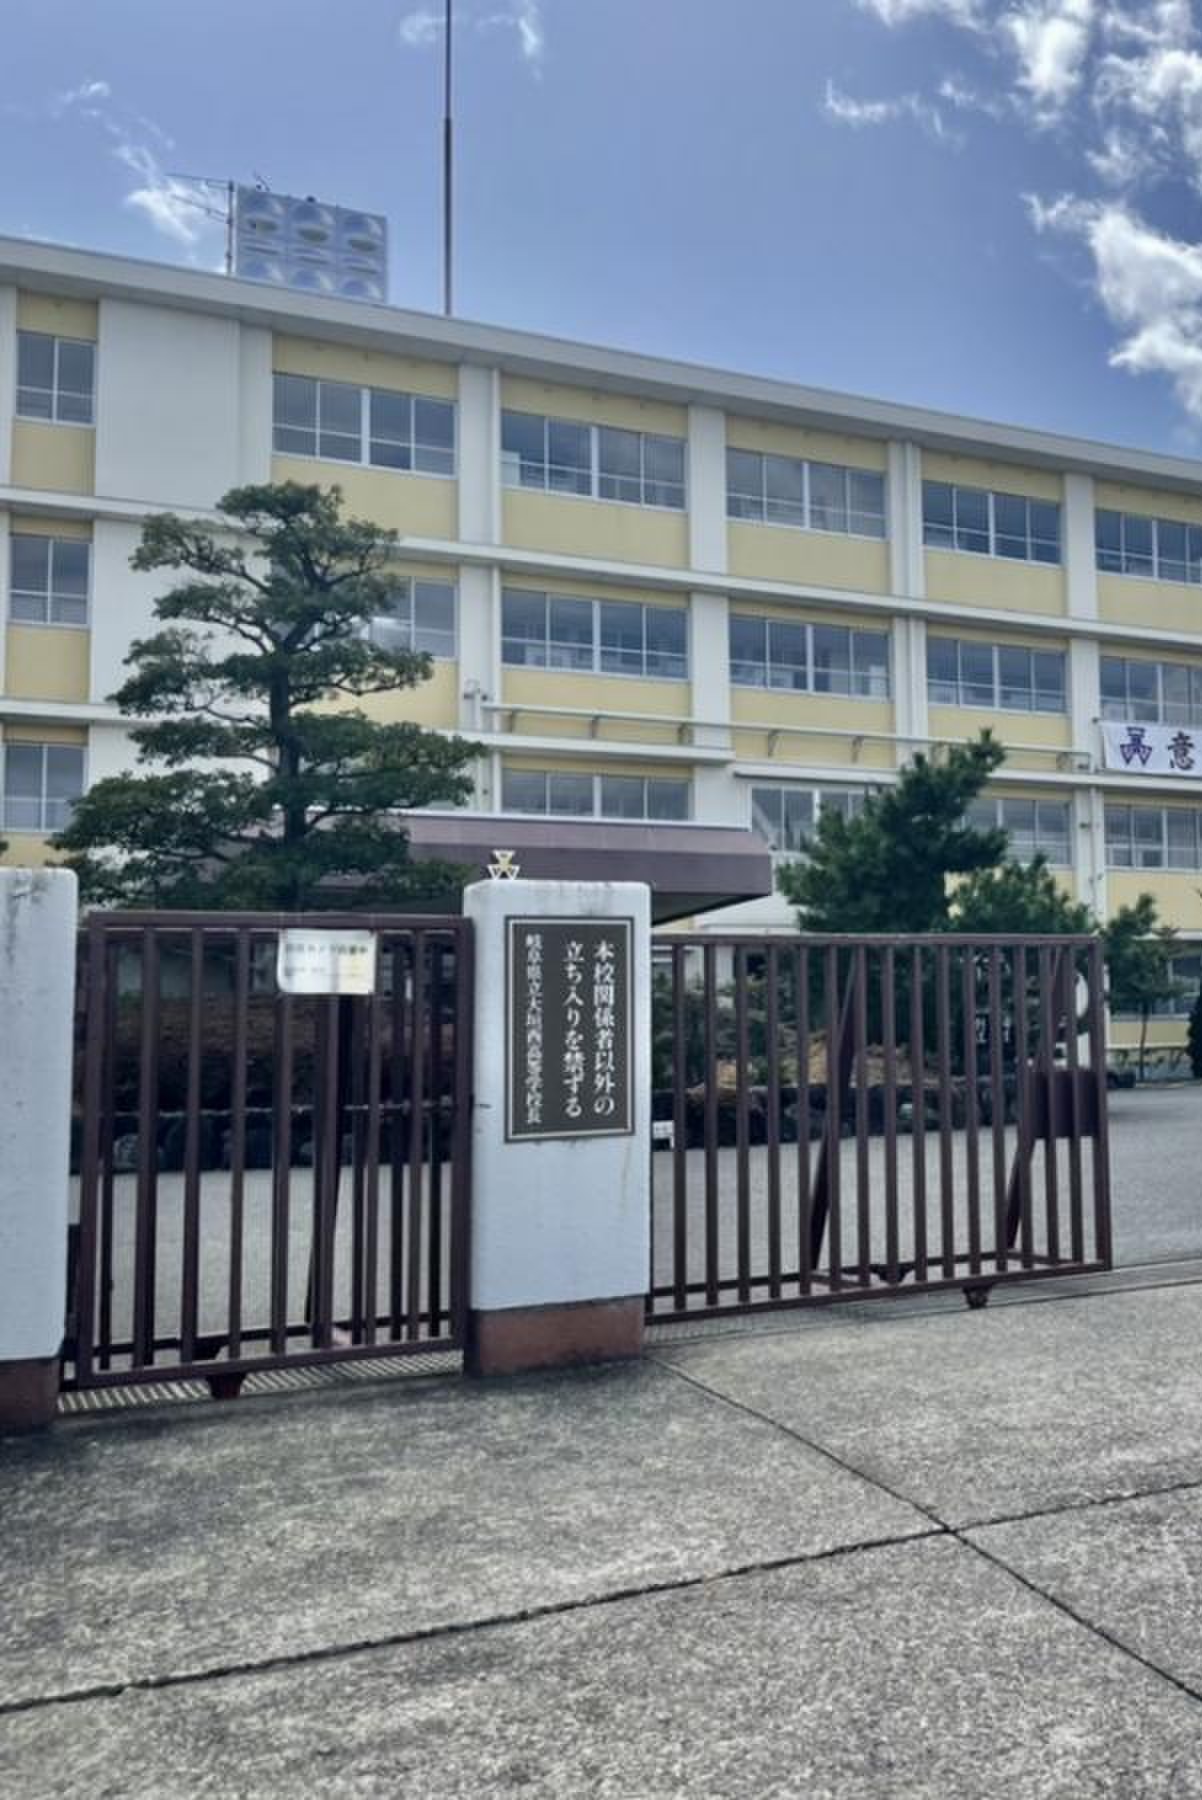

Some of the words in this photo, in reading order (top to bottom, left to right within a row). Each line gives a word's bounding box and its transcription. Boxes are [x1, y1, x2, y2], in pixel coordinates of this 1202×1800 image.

[563, 940, 585, 1118] 立ち入りを禁ずる
[593, 939, 615, 1116] 本校関係者以外の
